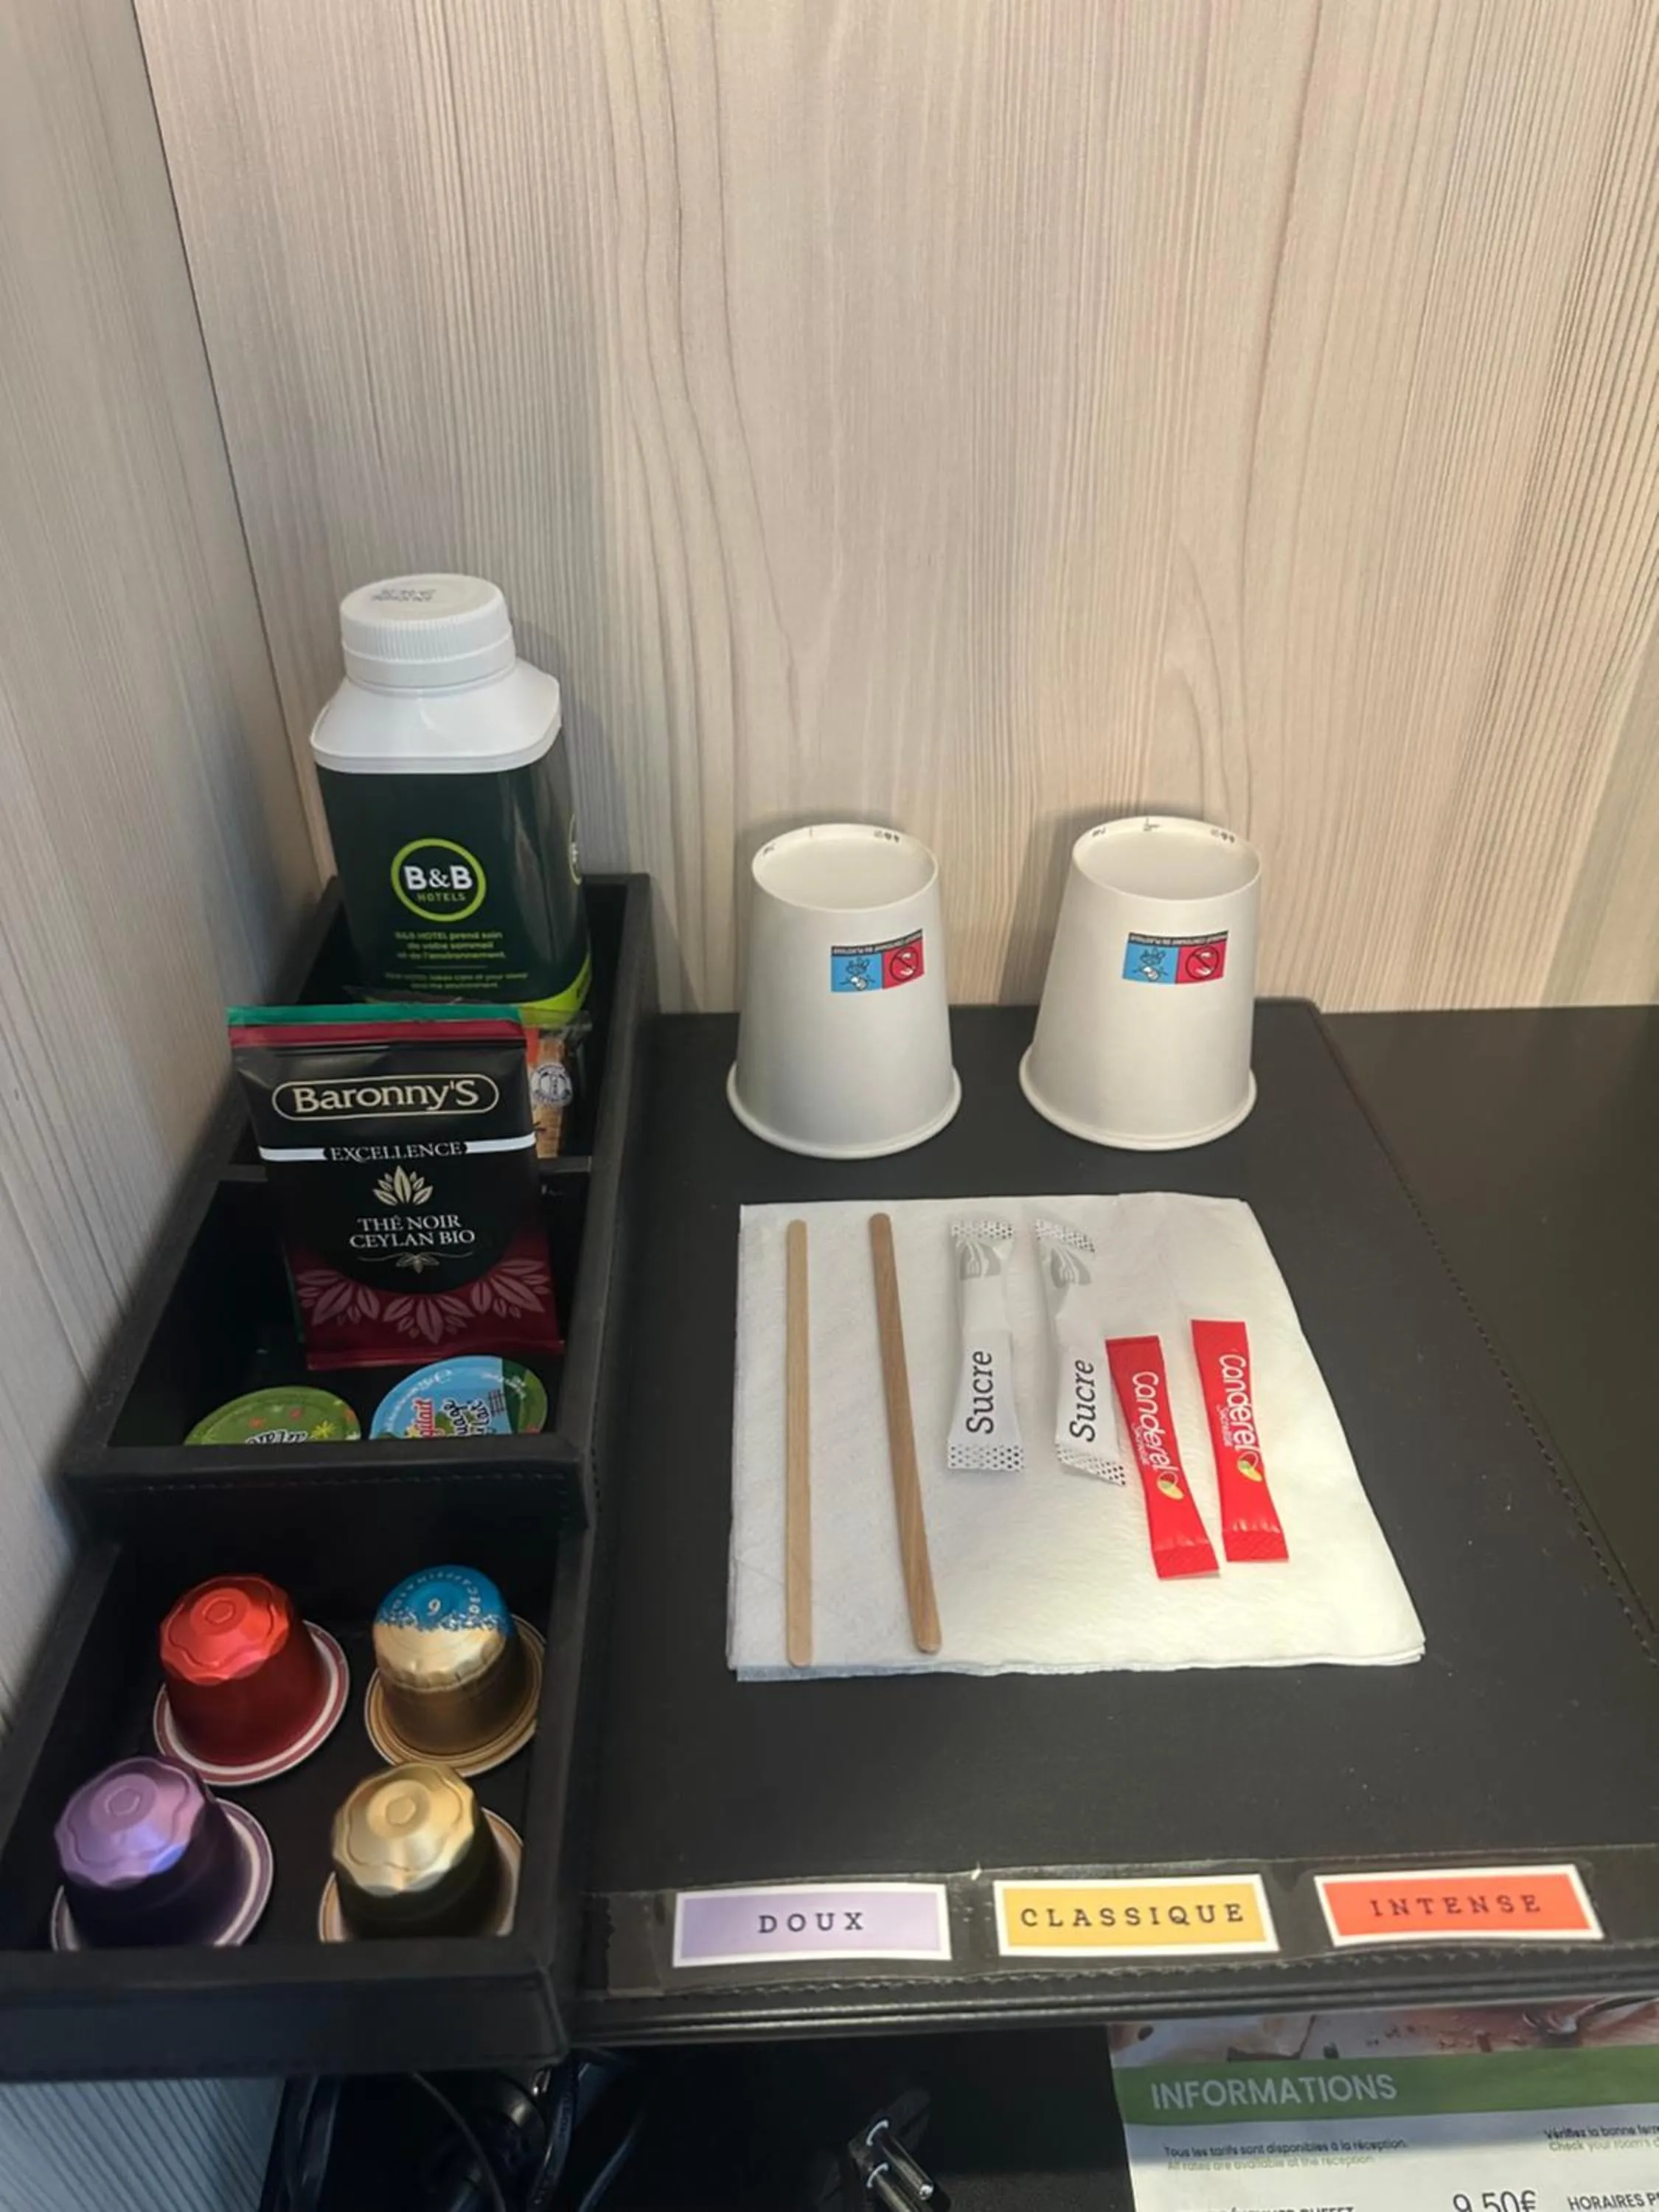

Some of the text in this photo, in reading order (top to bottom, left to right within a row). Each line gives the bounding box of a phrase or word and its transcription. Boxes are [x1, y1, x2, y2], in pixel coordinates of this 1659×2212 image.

[404, 865, 473, 890] B&B
[417, 891, 466, 903] HOTELS
[293, 1079, 479, 1112] Baronny'S
[330, 1142, 463, 1163] EXCELLENCE
[407, 1214, 462, 1230] NOIR
[349, 1229, 476, 1249] CEYLAN BIO
[965, 1350, 994, 1435] Sucre
[1070, 1359, 1096, 1442] Sucre
[1219, 1354, 1260, 1451] Canderel
[1132, 1371, 1178, 1473] Canderel
[1020, 1904, 1243, 1927] CLASSIQUE
[1369, 1894, 1541, 1917] INTENSE
[758, 1912, 865, 1934] DOUX
[1151, 2074, 1397, 2110] INFORMATIONS
[1164, 2146, 1190, 2157] Tous
[1209, 2144, 1239, 2156] tarifs
[1240, 2144, 1265, 2154] sont
[1266, 2141, 1328, 2155] disponibles
[1549, 2140, 1585, 2152] Check
[1568, 2194, 1645, 2211] HORAIRES
